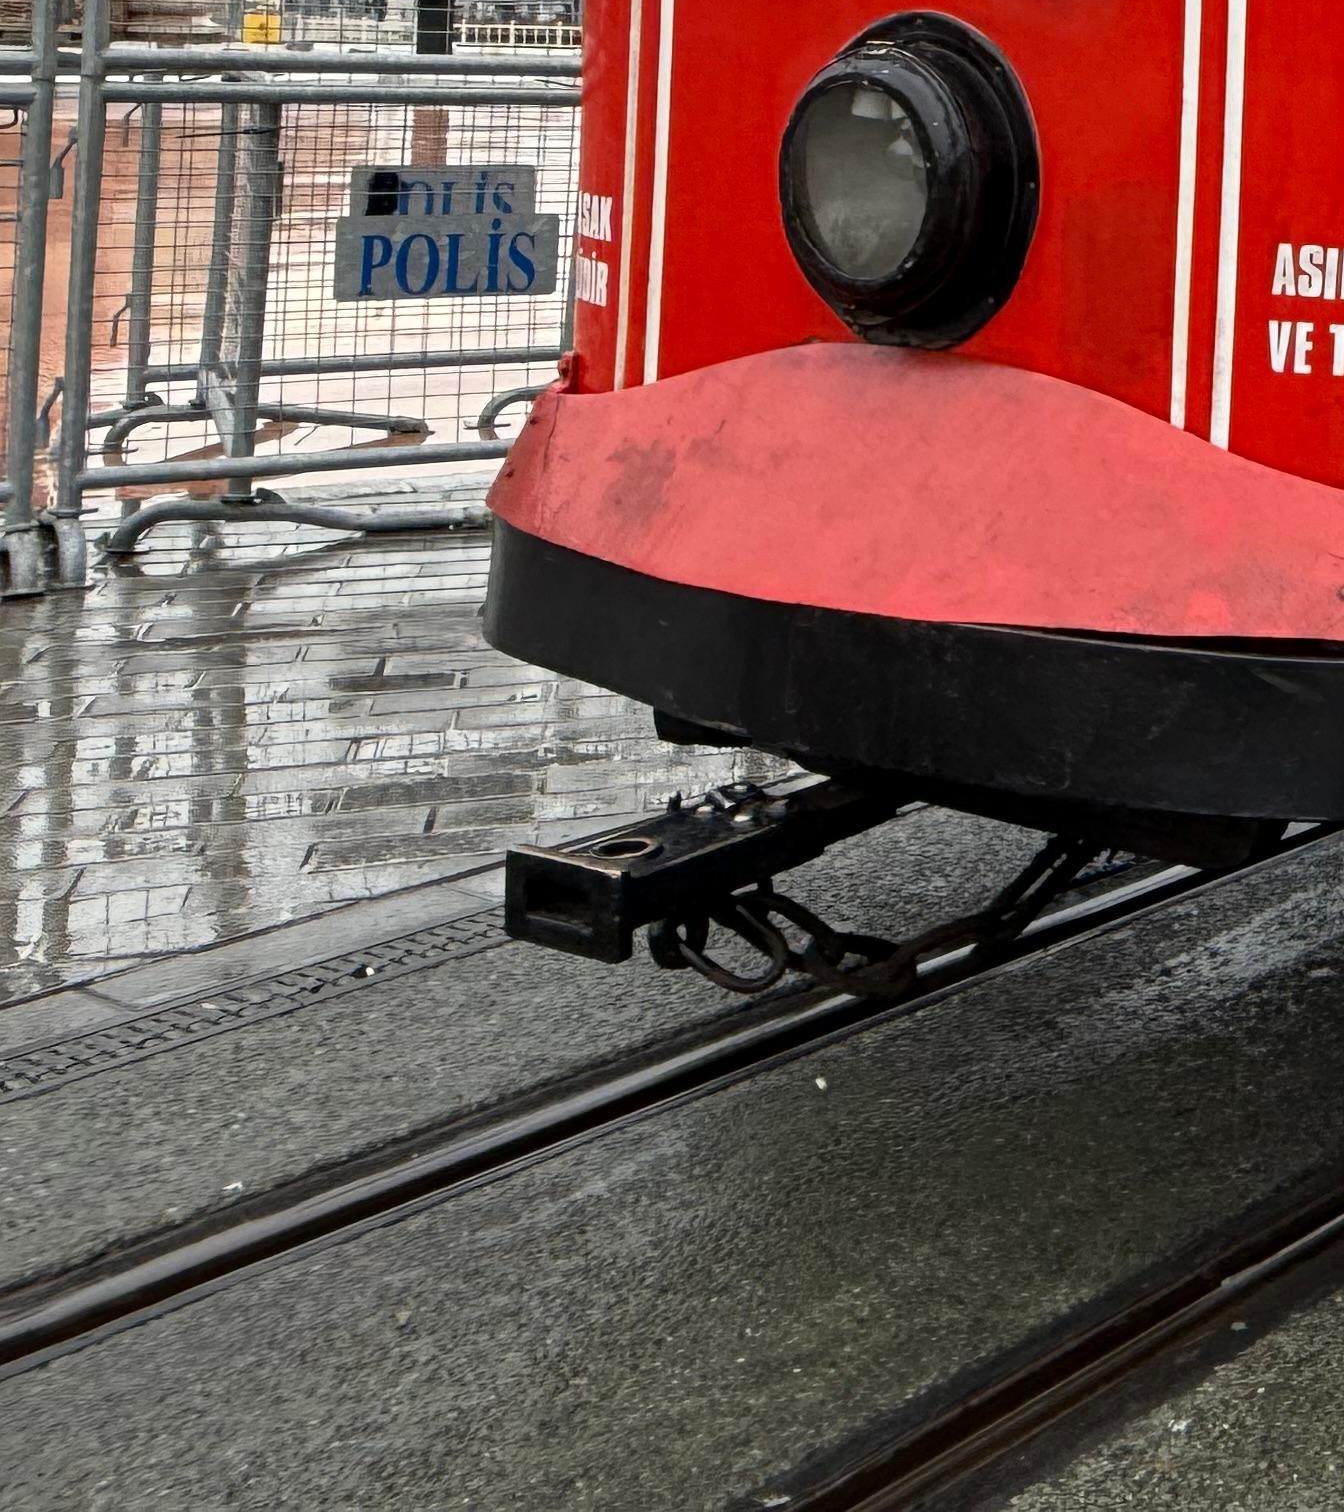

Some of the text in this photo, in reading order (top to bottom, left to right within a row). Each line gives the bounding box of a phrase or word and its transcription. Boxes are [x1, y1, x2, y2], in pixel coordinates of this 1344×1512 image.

[395, 171, 515, 216] OLİS
[358, 218, 536, 297] POLİS
[1268, 319, 1315, 375] VE
